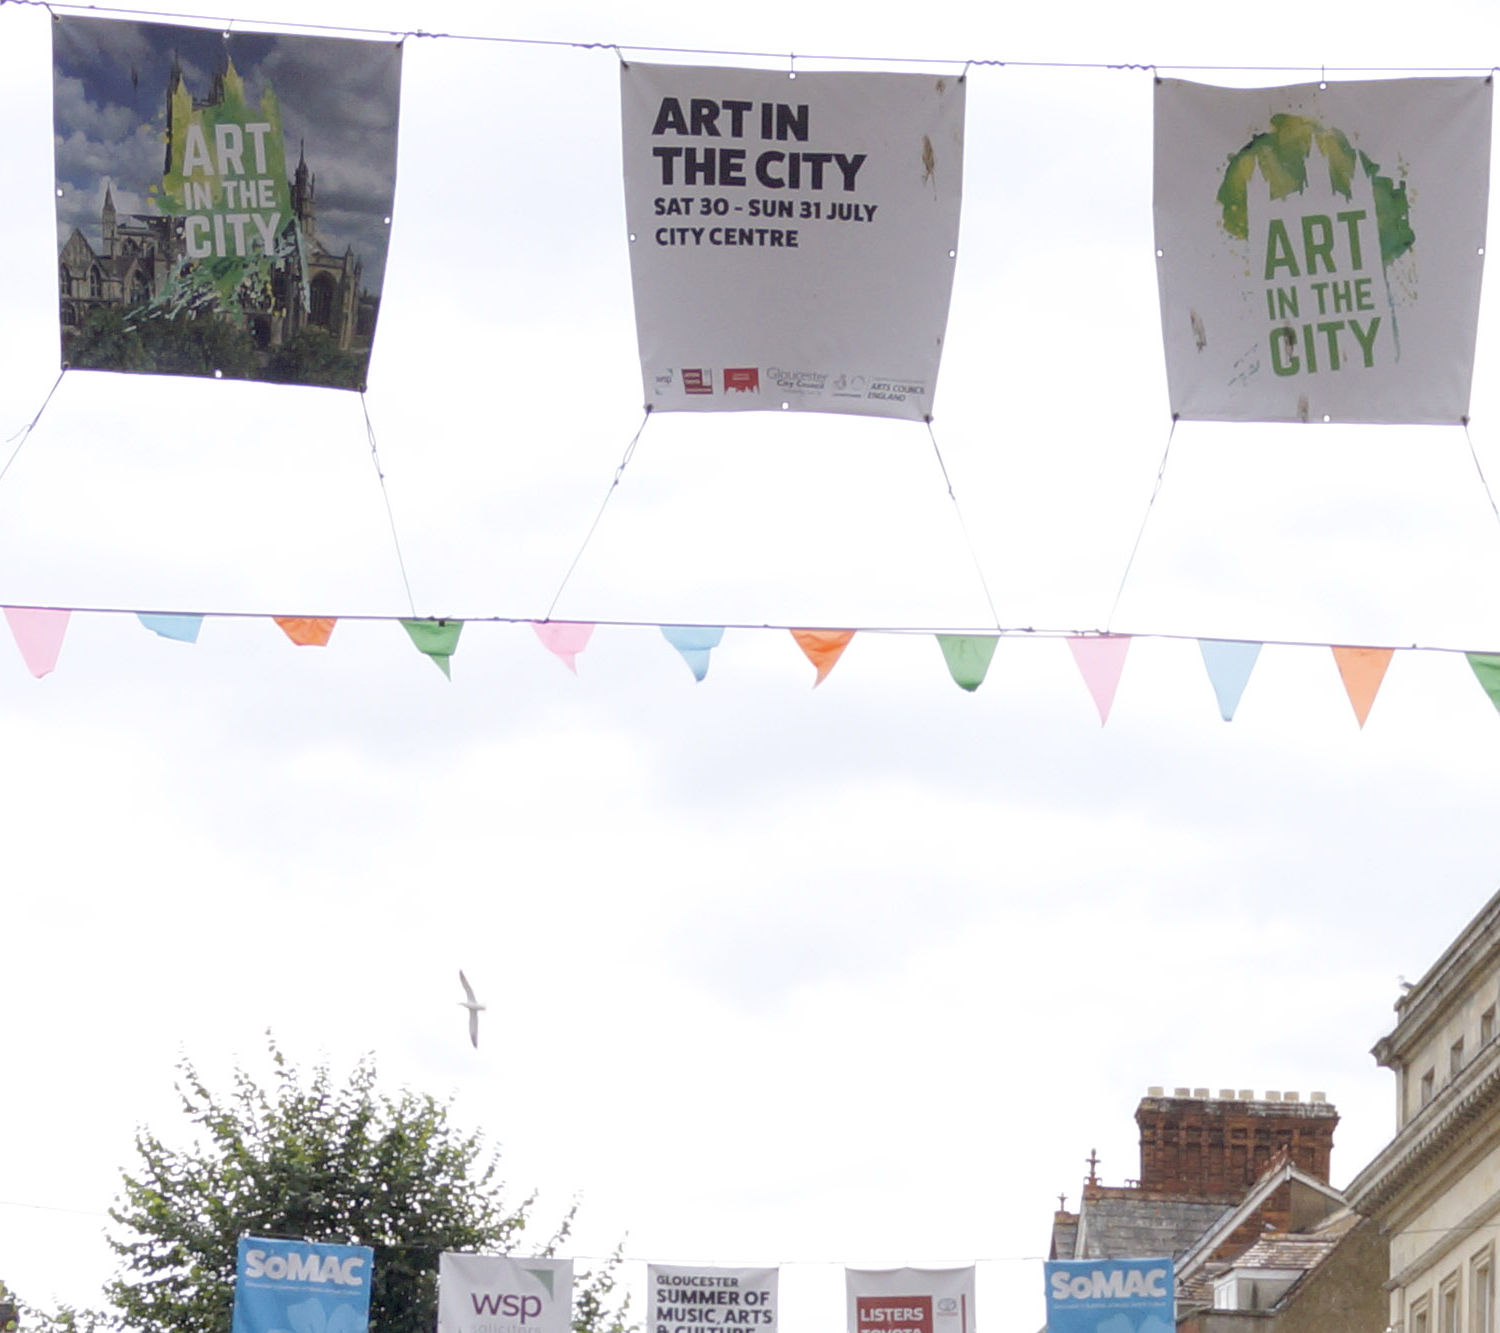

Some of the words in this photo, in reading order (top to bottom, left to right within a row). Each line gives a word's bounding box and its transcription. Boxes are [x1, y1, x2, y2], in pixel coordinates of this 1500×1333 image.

[651, 97, 753, 138] ART
[761, 102, 809, 142] IN
[182, 122, 271, 177] ART
[652, 146, 747, 187] THE
[755, 150, 867, 192] CITY
[183, 181, 213, 211] IN
[220, 179, 276, 209] THE
[654, 197, 695, 216] SAT
[700, 197, 730, 216] 30
[748, 199, 794, 218] SUN
[799, 201, 821, 220] 31
[826, 202, 878, 222] JULY
[185, 212, 281, 259] CITY
[655, 227, 705, 246] CITY
[709, 228, 799, 248] CENTRE
[1264, 210, 1367, 280] ART
[1266, 285, 1300, 320] IN
[1310, 278, 1375, 315] THE
[1269, 317, 1382, 377] CITY
[766, 366, 828, 382] Gloucester
[244, 1249, 365, 1286] SoMAC
[656, 1275, 739, 1288] GLOUCESTER
[657, 1289, 740, 1305] SUMMER
[744, 1291, 770, 1306] OF
[1051, 1269, 1166, 1299] SoMAC
[471, 1292, 542, 1324] wsp
[657, 1307, 721, 1325] MUSIC,
[723, 1309, 773, 1324] ARTS
[861, 1307, 924, 1322] LISTERS
